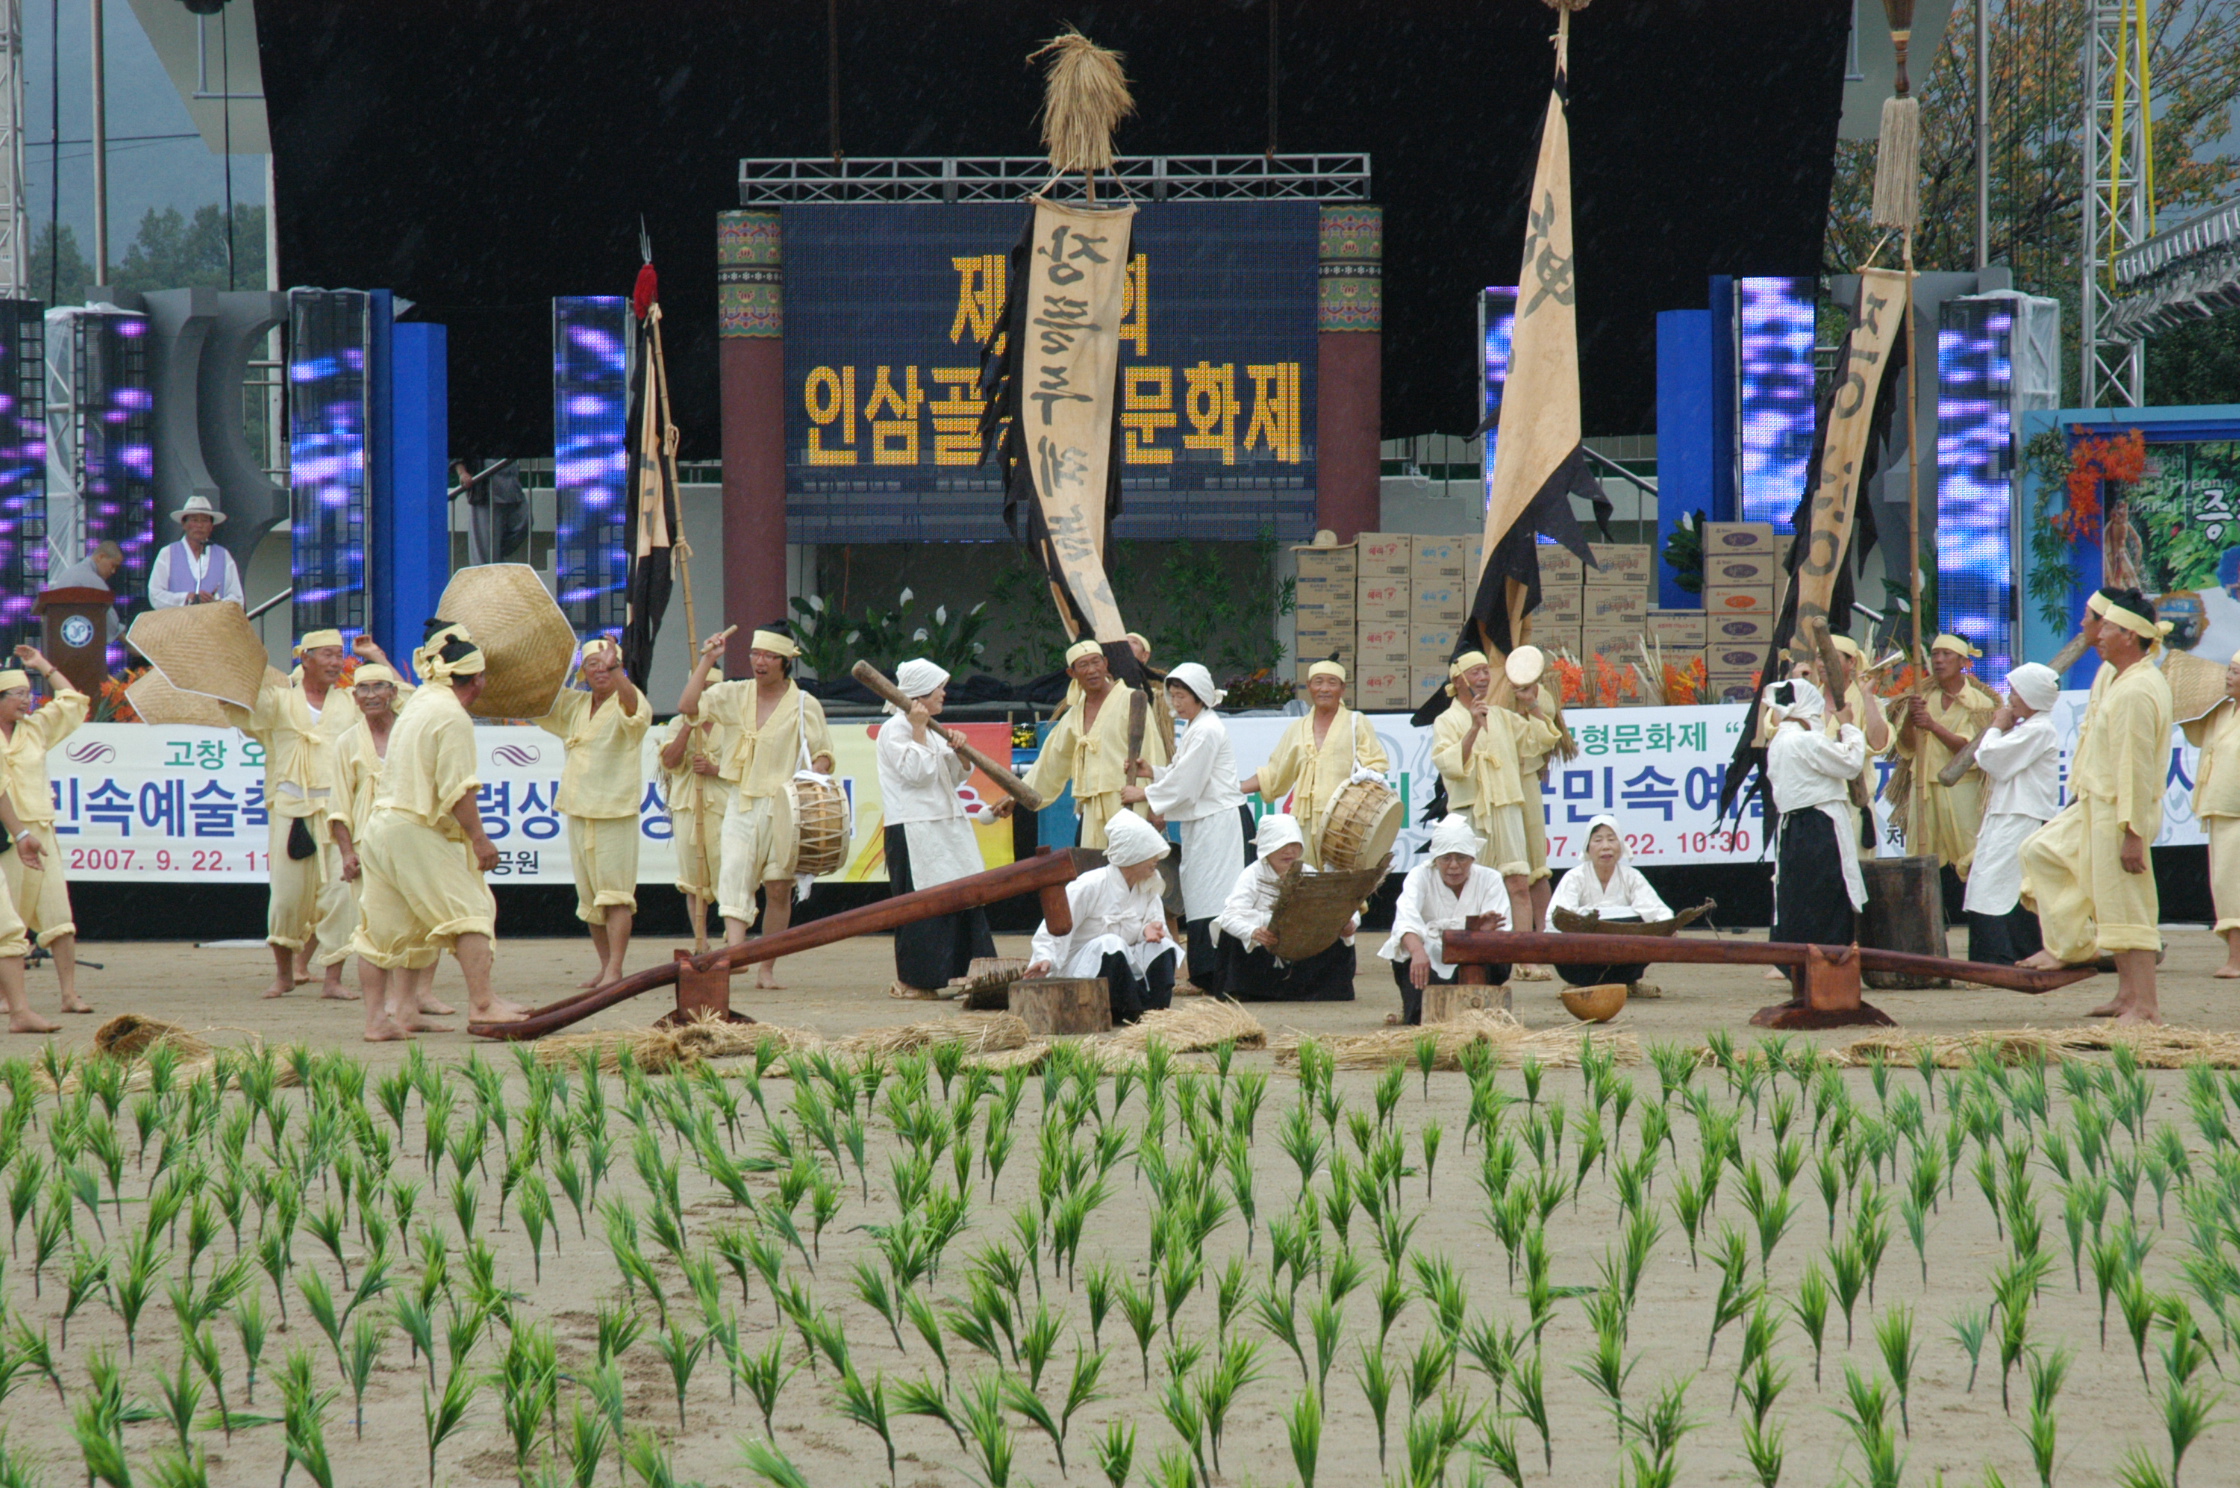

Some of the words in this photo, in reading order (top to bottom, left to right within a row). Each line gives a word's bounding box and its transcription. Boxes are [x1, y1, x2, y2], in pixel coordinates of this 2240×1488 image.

[1568, 721, 1707, 756] 형문화제
[164, 739, 227, 770] 고창
[1677, 830, 1751, 854] 10:30
[71, 848, 145, 870] 2007.
[156, 849, 179, 870] 9.
[192, 850, 233, 870] 22.
